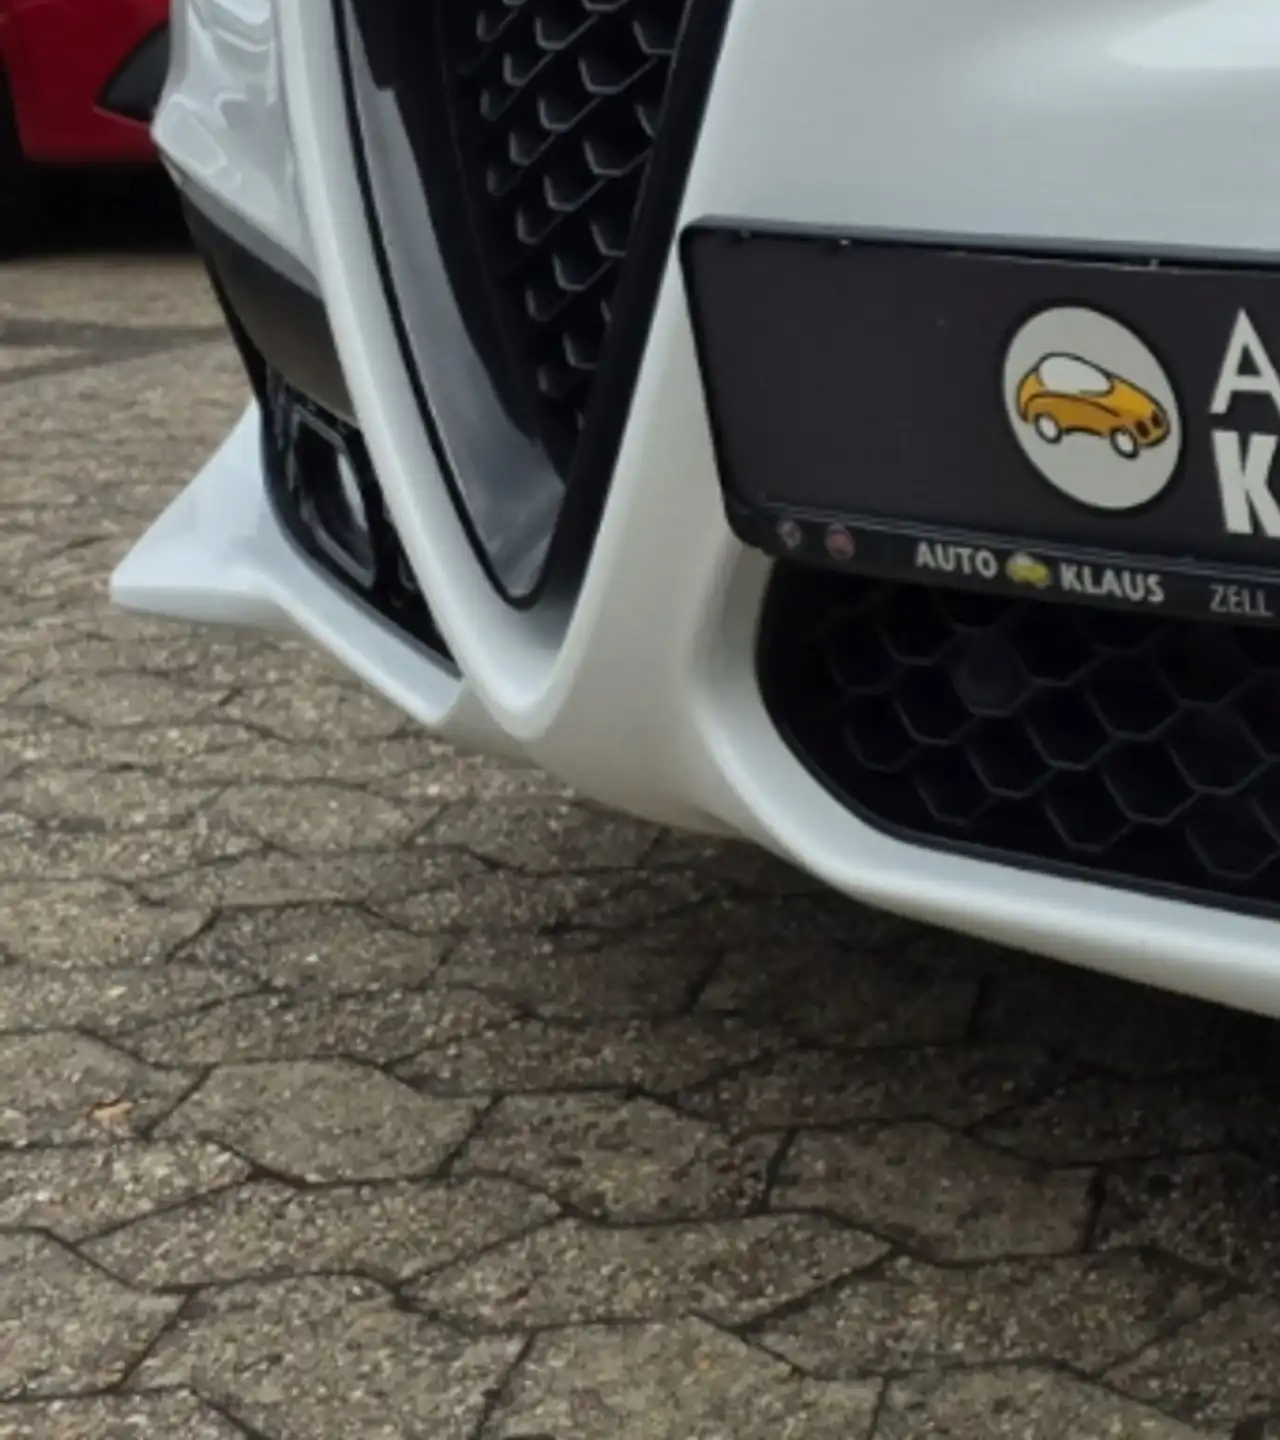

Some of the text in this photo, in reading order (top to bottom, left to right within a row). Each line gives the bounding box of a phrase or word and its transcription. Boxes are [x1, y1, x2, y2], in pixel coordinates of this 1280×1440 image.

[915, 541, 998, 579] AUTO
[1058, 561, 1166, 604] KLAUS
[1209, 583, 1275, 618] ZELL
